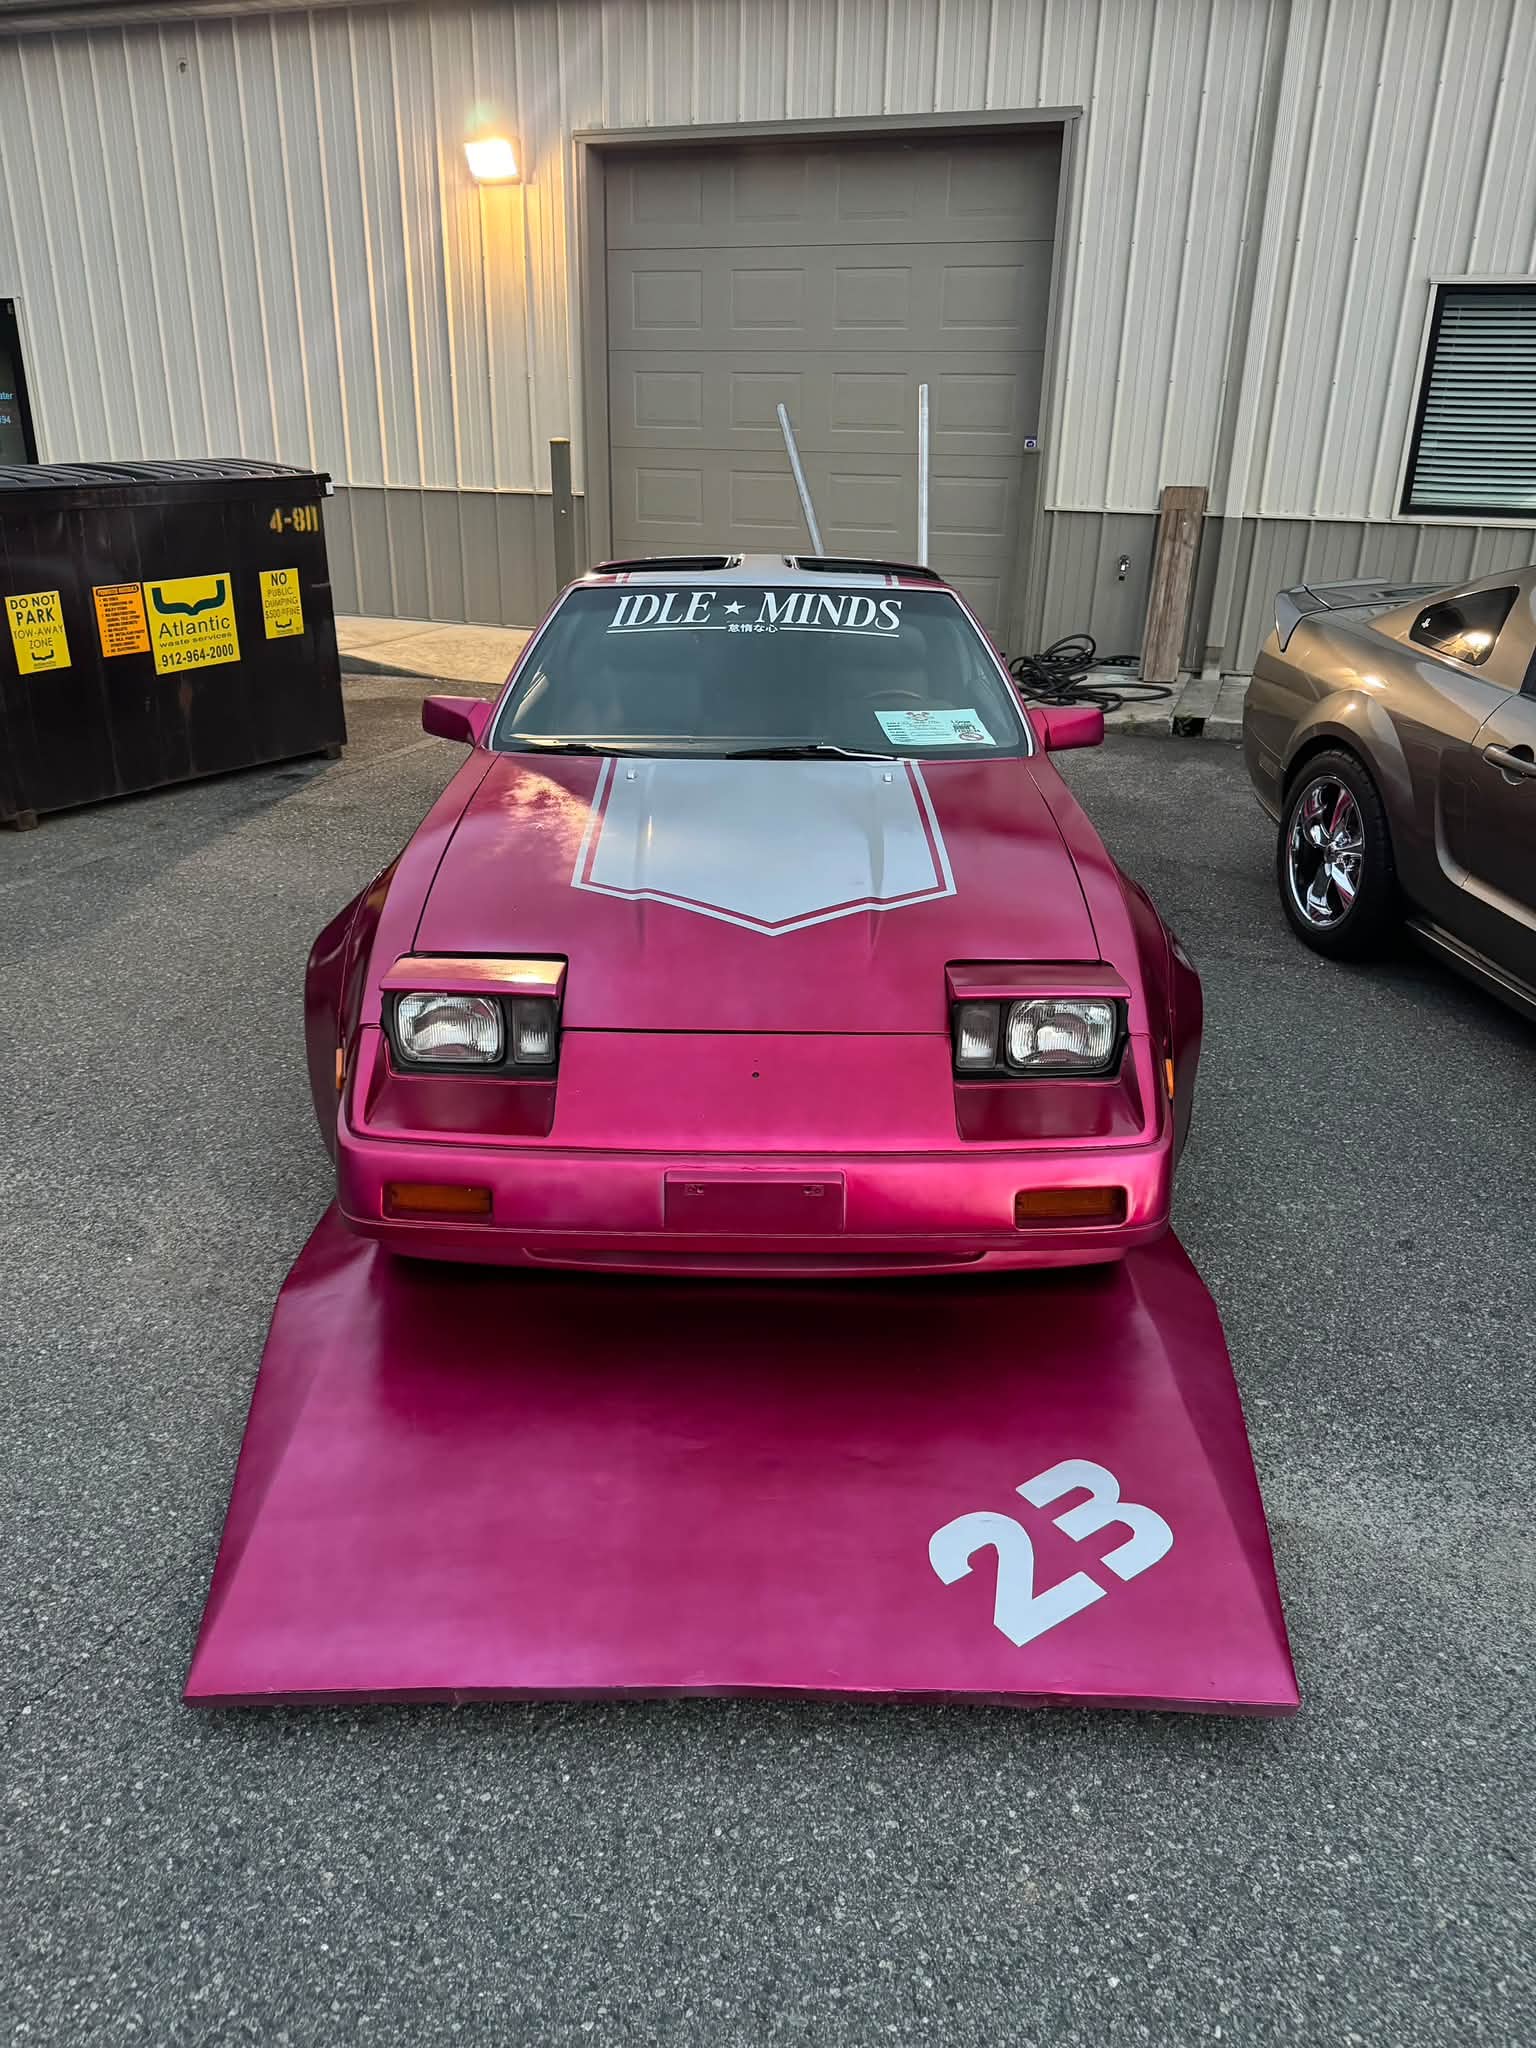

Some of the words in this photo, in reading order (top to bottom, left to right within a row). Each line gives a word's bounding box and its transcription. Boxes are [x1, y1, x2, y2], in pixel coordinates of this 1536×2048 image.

[269, 505, 319, 533] 4-811
[271, 572, 287, 586] NO
[267, 587, 293, 598] PUBLIC
[10, 598, 28, 610] DO
[32, 594, 55, 607] NOT
[265, 596, 299, 609] DUMPING
[16, 607, 55, 626] PARK
[286, 606, 301, 617] FINE
[608, 591, 717, 628] IDLE
[755, 591, 902, 631] MINDS
[12, 624, 64, 640] TOW-AWAY
[159, 615, 231, 639] Atlantic
[29, 637, 53, 650] ZONE
[160, 637, 190, 648] waste
[193, 631, 232, 644] services
[161, 643, 235, 667] 912-964-2000
[928, 1458, 1174, 1648] 23
